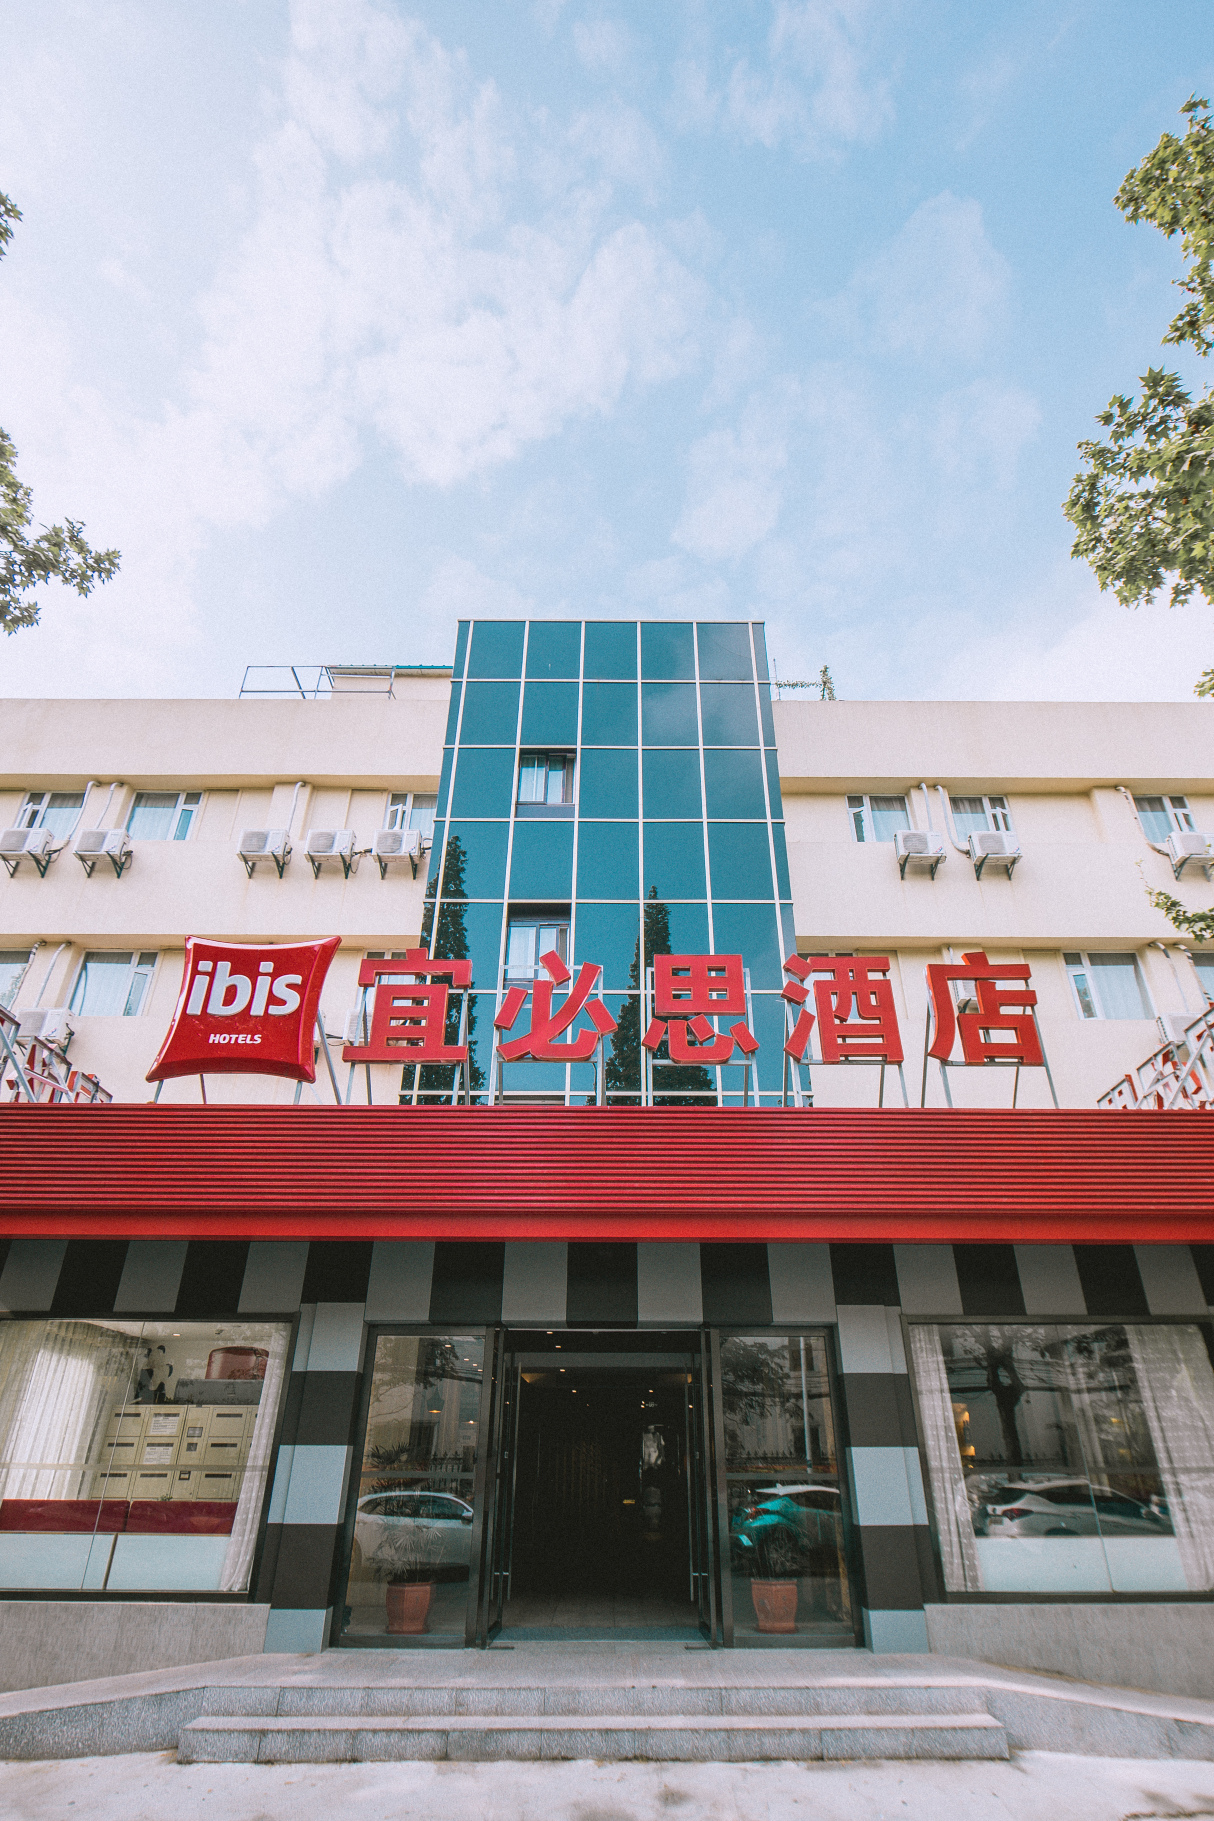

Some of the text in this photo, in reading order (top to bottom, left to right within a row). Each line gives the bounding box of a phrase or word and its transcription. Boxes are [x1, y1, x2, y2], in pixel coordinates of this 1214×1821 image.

[186, 960, 302, 1016] ibis
[342, 947, 1044, 1065] 宜必思酒店
[208, 1033, 262, 1044] HOTELS
